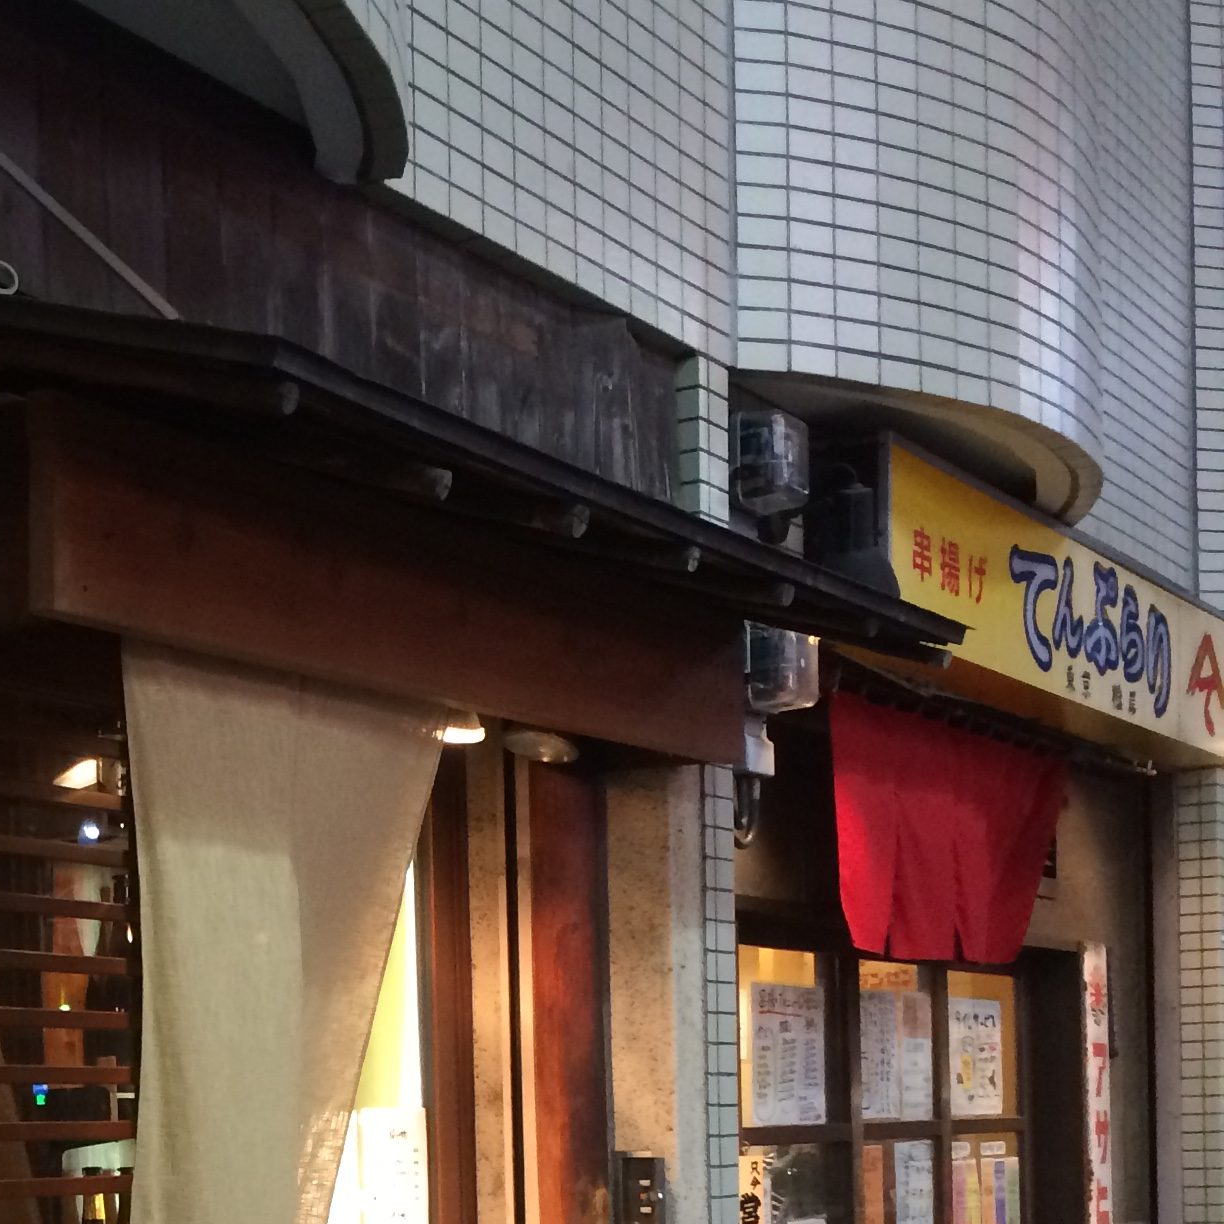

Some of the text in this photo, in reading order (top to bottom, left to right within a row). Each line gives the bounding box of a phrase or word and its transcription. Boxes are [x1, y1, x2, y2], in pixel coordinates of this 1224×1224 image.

[912, 526, 988, 604] 串揚げ
[1009, 543, 1171, 718] てんぷらり
